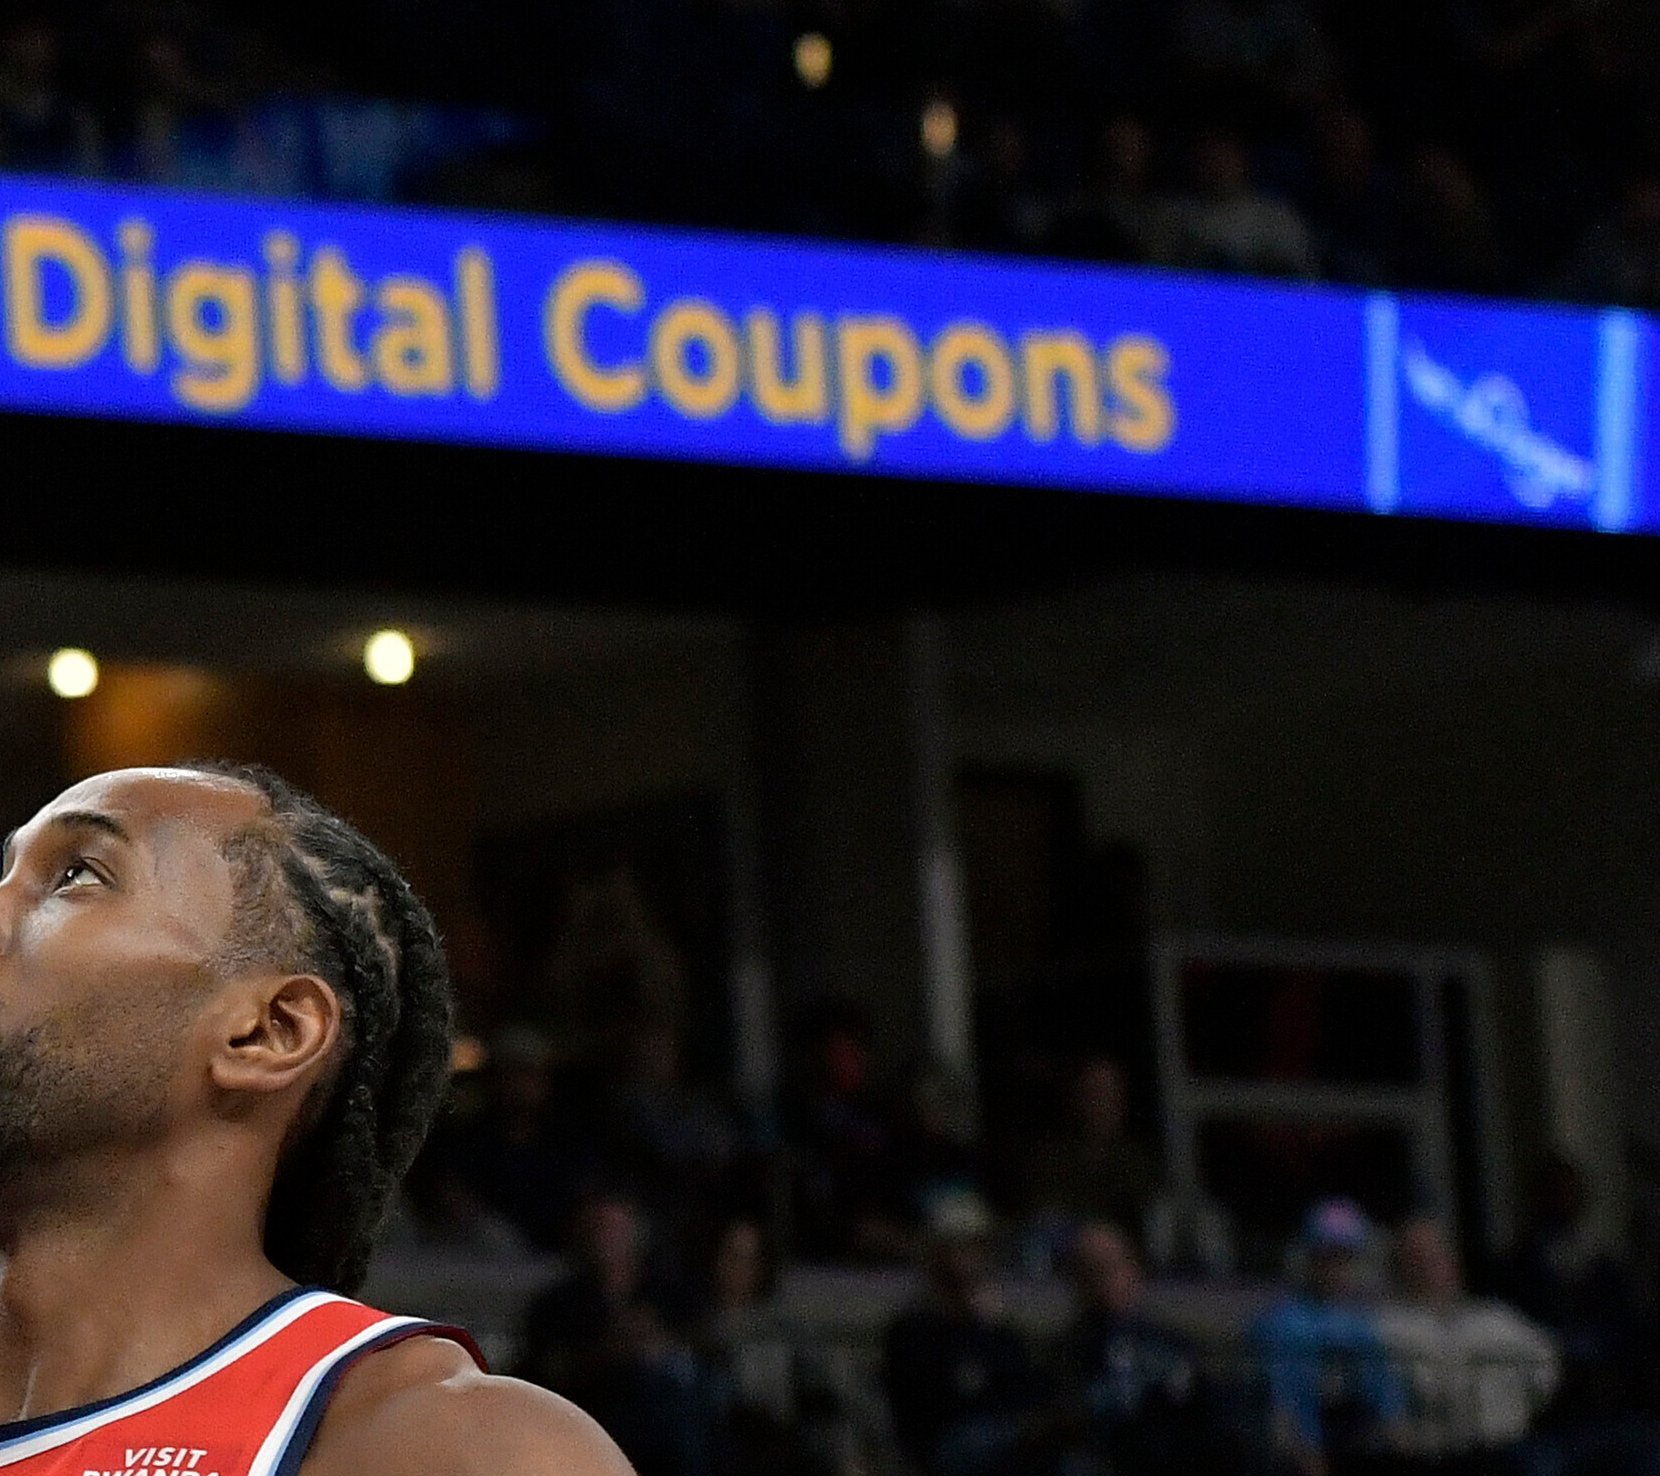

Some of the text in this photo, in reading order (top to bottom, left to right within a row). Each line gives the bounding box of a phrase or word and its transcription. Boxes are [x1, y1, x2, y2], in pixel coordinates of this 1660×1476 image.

[0, 211, 501, 415] Digital
[542, 256, 1178, 464] Coupons
[124, 1446, 208, 1468] VISIT
